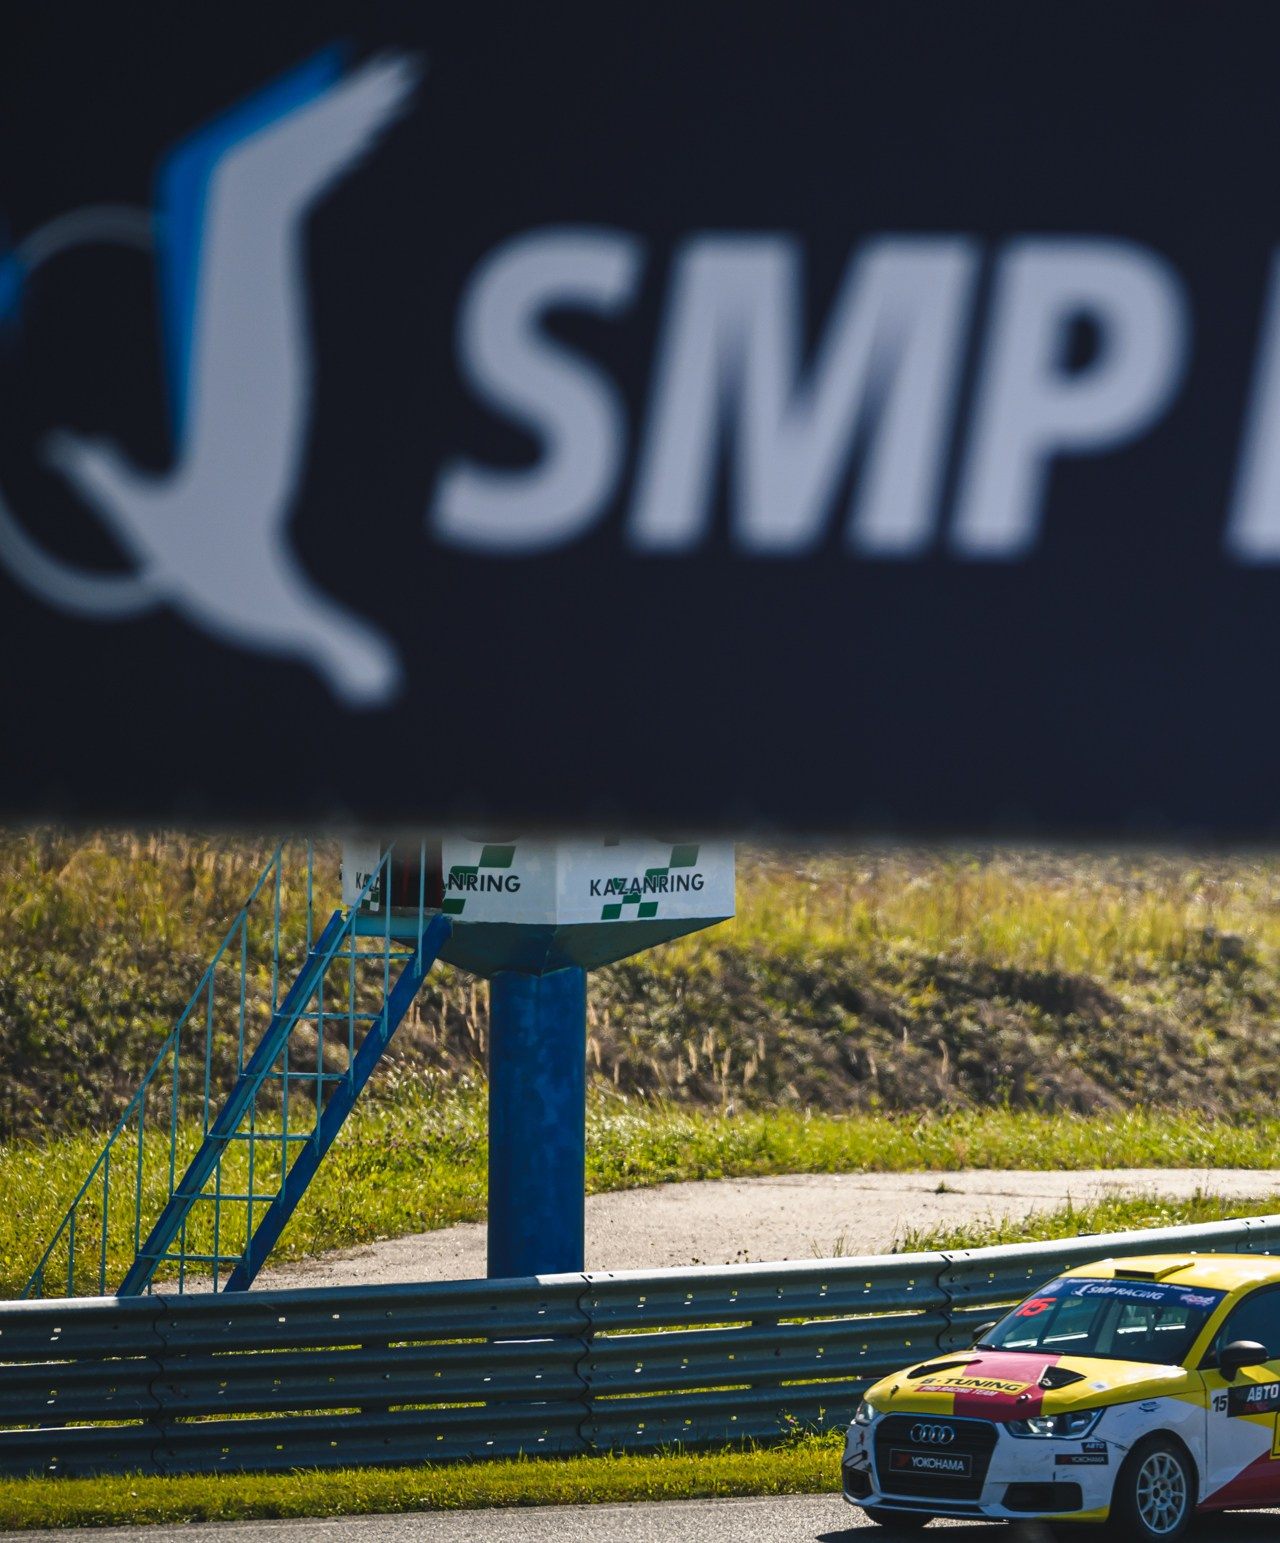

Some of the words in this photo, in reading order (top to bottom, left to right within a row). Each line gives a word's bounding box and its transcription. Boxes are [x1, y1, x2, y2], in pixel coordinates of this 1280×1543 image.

[431, 226, 1191, 558] SMP
[442, 873, 521, 892] NRING
[589, 872, 705, 897] KAZANRING
[1087, 1285, 1117, 1296] SMP
[1115, 1288, 1165, 1301] RACING
[1015, 1297, 1056, 1317] 15
[1212, 1395, 1228, 1412] 15
[911, 1456, 965, 1471] YOKOHAMA
